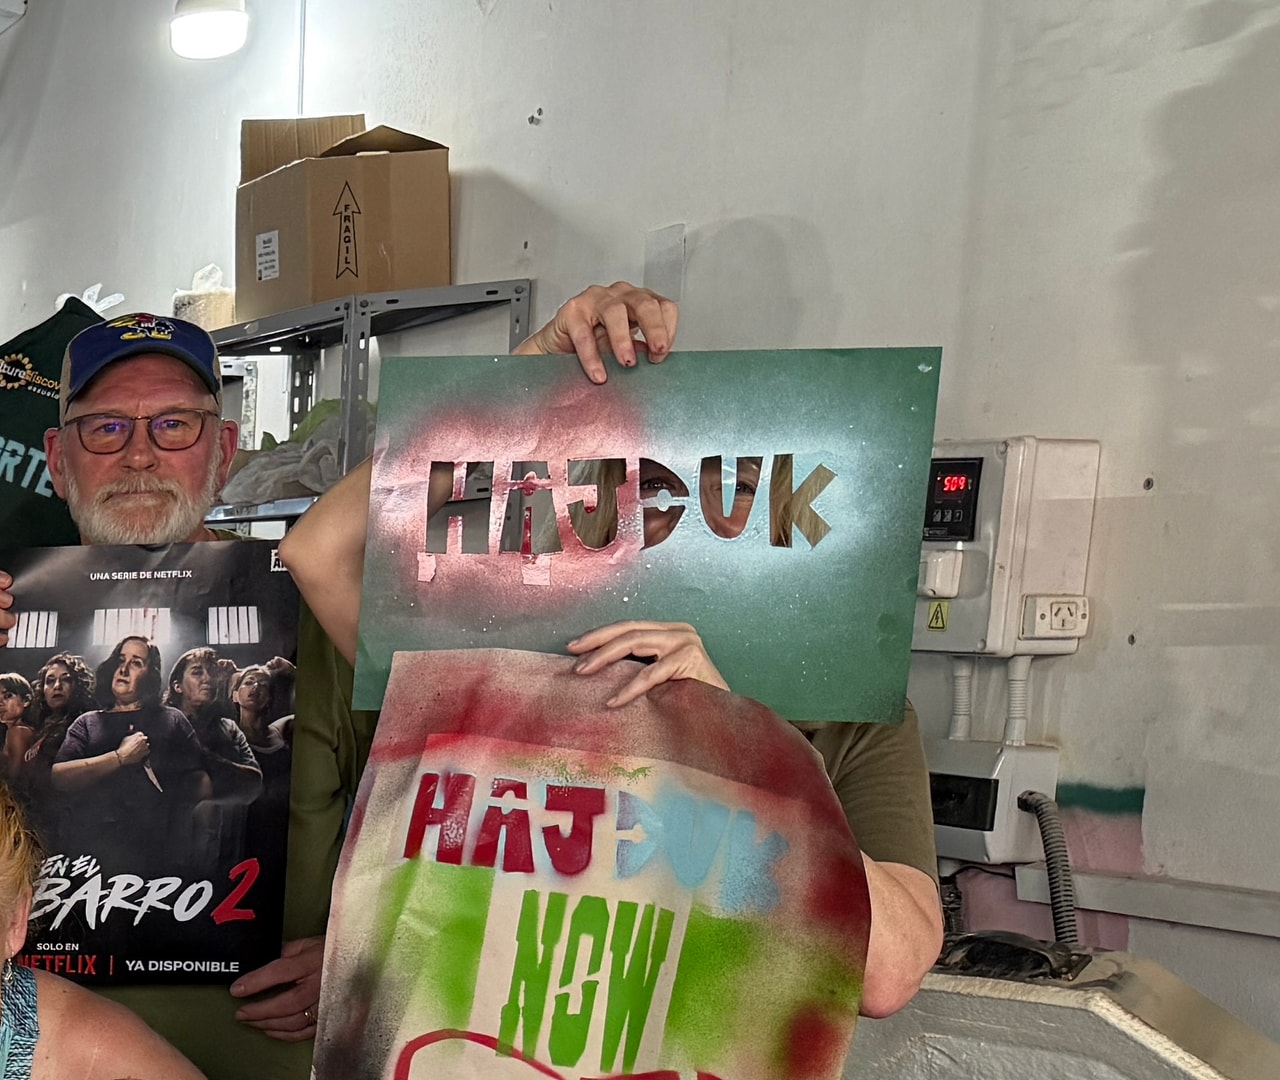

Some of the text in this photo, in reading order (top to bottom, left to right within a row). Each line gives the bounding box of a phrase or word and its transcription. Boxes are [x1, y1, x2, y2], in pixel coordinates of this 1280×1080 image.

[343, 204, 352, 265] FRAGIL
[943, 476, 966, 491] 509
[424, 453, 838, 551] HAJDUK
[90, 570, 192, 581] UNA SERIE DE NETFLIX
[40, 854, 101, 878] EN EL
[28, 857, 260, 932] BARRO 2
[36, 943, 79, 951] SOLO EN
[18, 954, 240, 975] NETFLIX YA DISPONIBLE
[495, 889, 675, 1074] NOW
